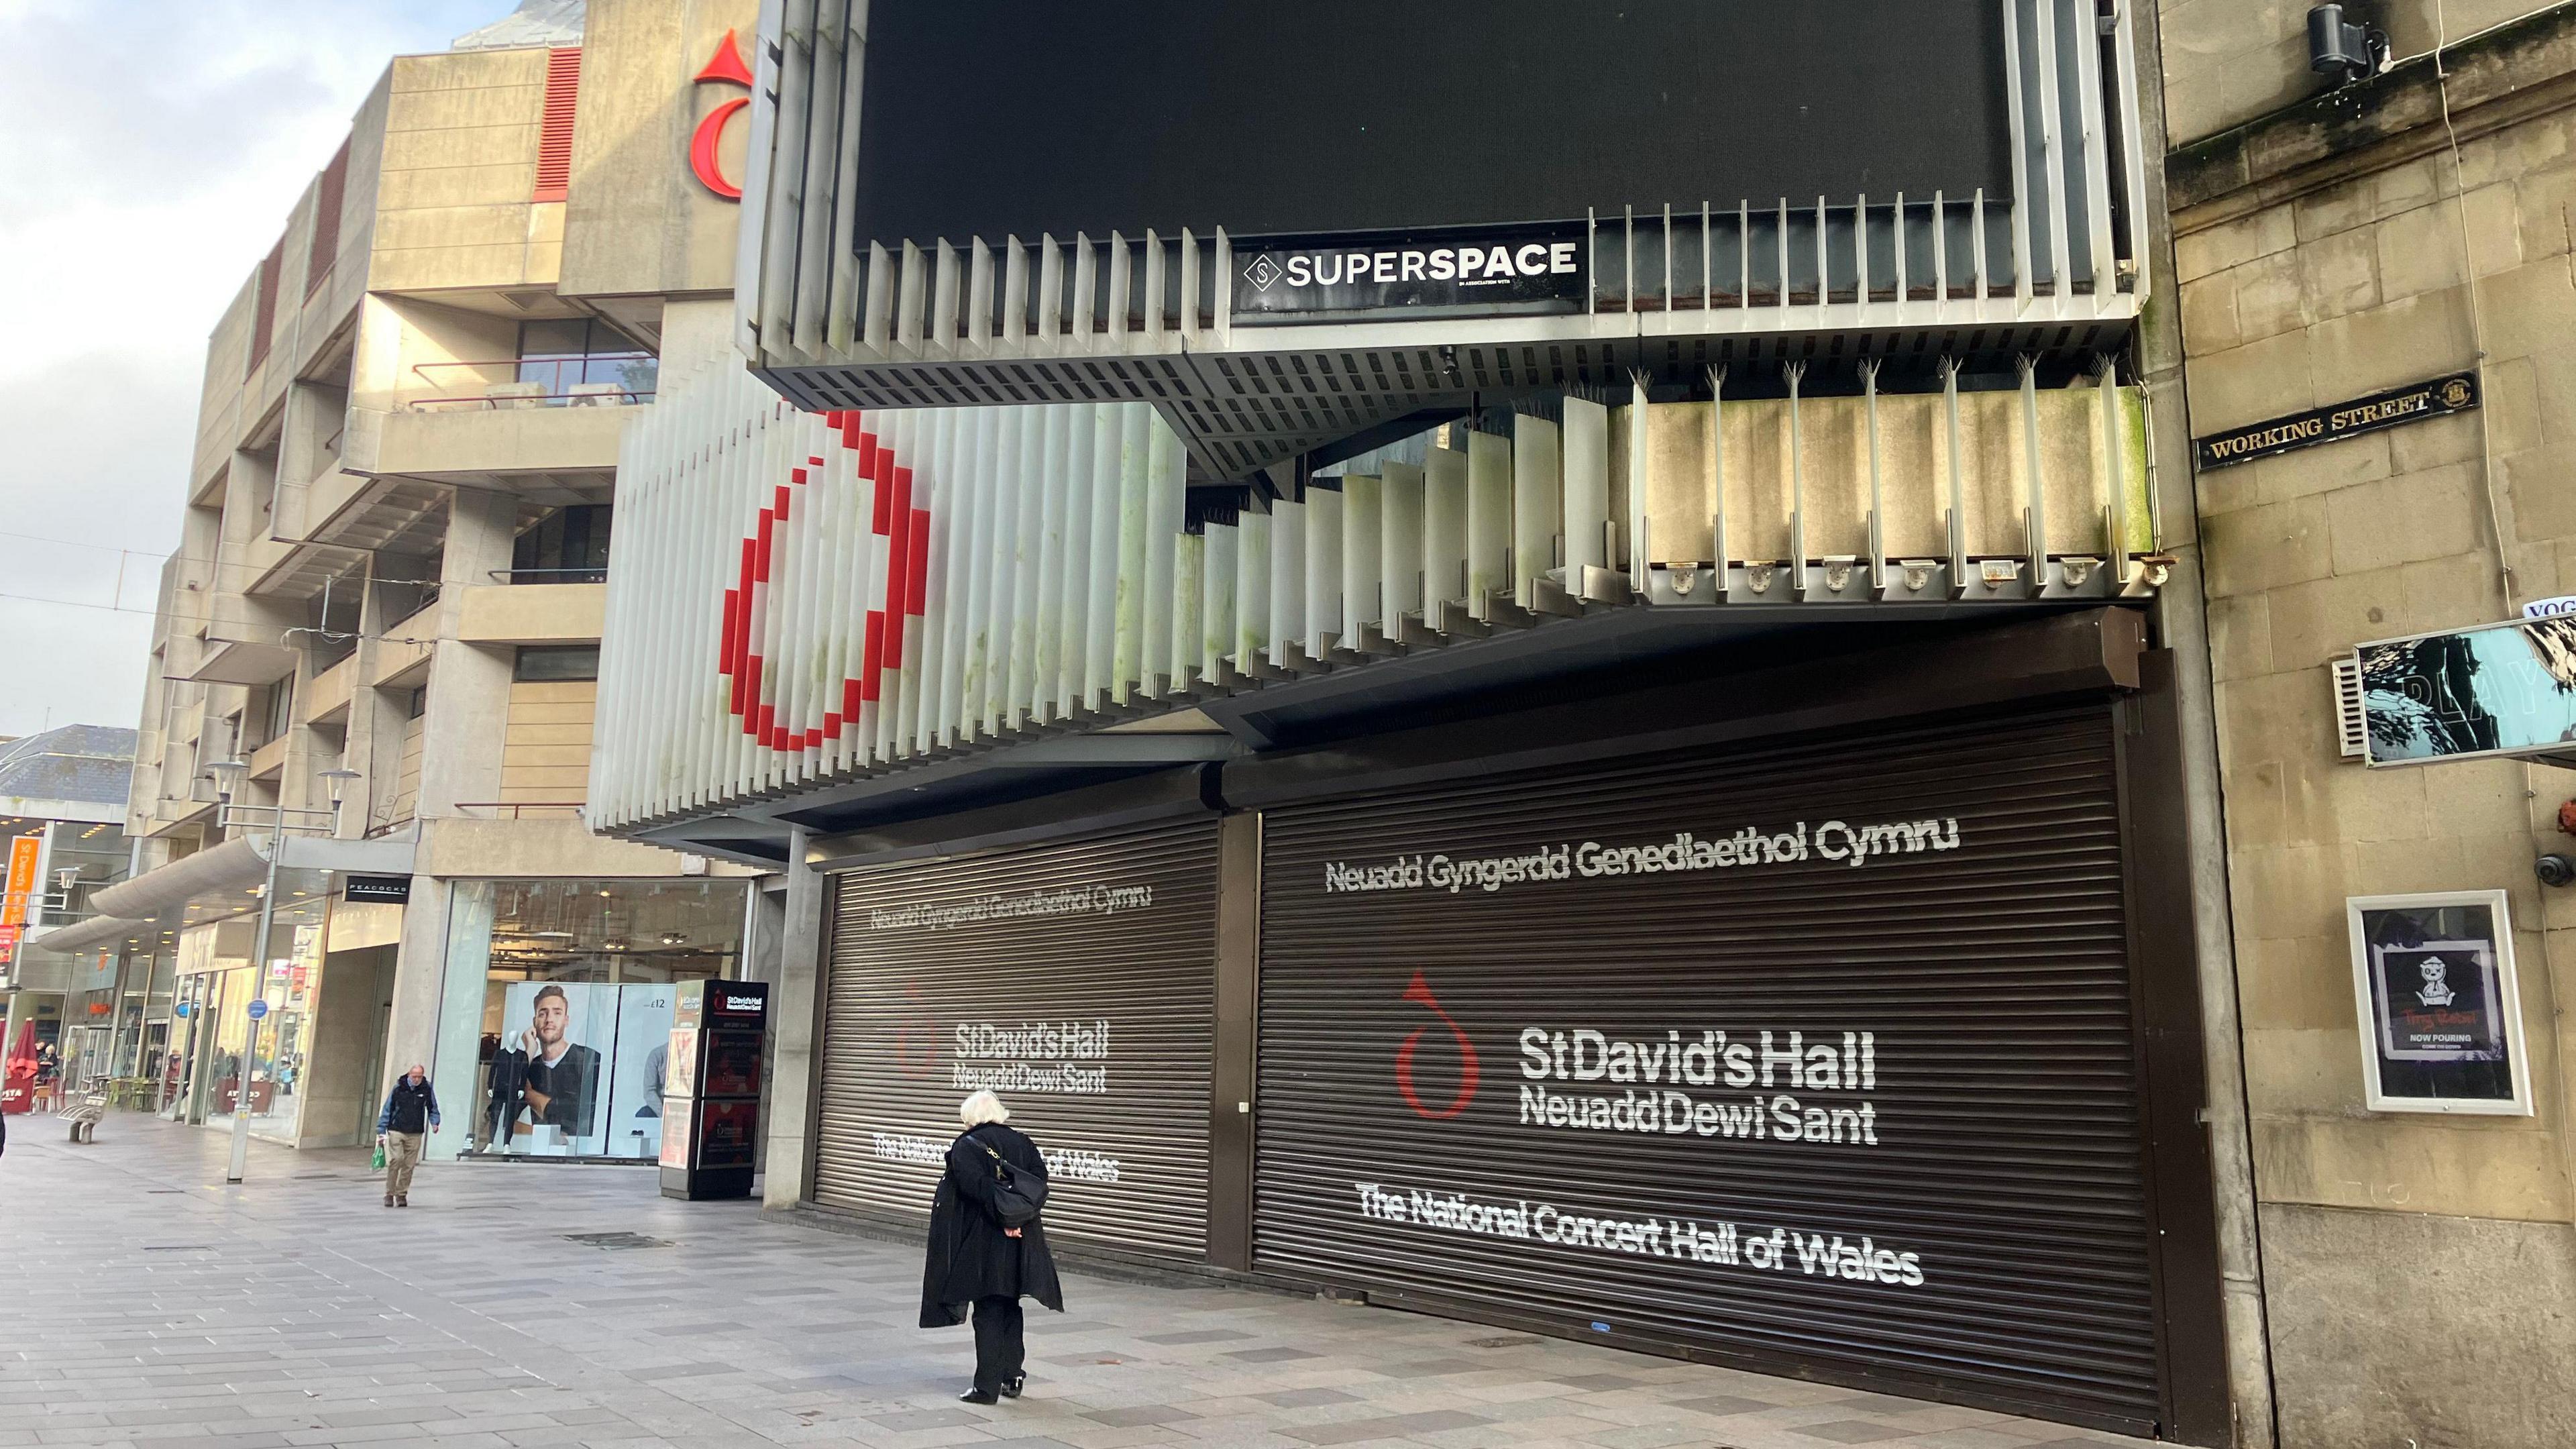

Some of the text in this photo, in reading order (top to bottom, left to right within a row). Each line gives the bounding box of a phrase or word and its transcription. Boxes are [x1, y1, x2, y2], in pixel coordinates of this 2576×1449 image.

[1287, 242, 1576, 286] SUPERSPACE
[2210, 418, 2324, 460] WORKING
[2331, 390, 2432, 432] STREET
[2402, 659, 2539, 724] PLAY
[1326, 818, 1960, 893] Neuadd Gyngerdd Genedlaethol Cymru
[1094, 885, 1152, 914] Cymru
[1061, 1020, 1109, 1059] Hall
[1761, 1030, 1876, 1089] Hall
[1662, 1091, 1765, 1139] Dewi
[1770, 1094, 1878, 1146] Sant
[1355, 1183, 1925, 1287] The National Concert Hall of Wales
